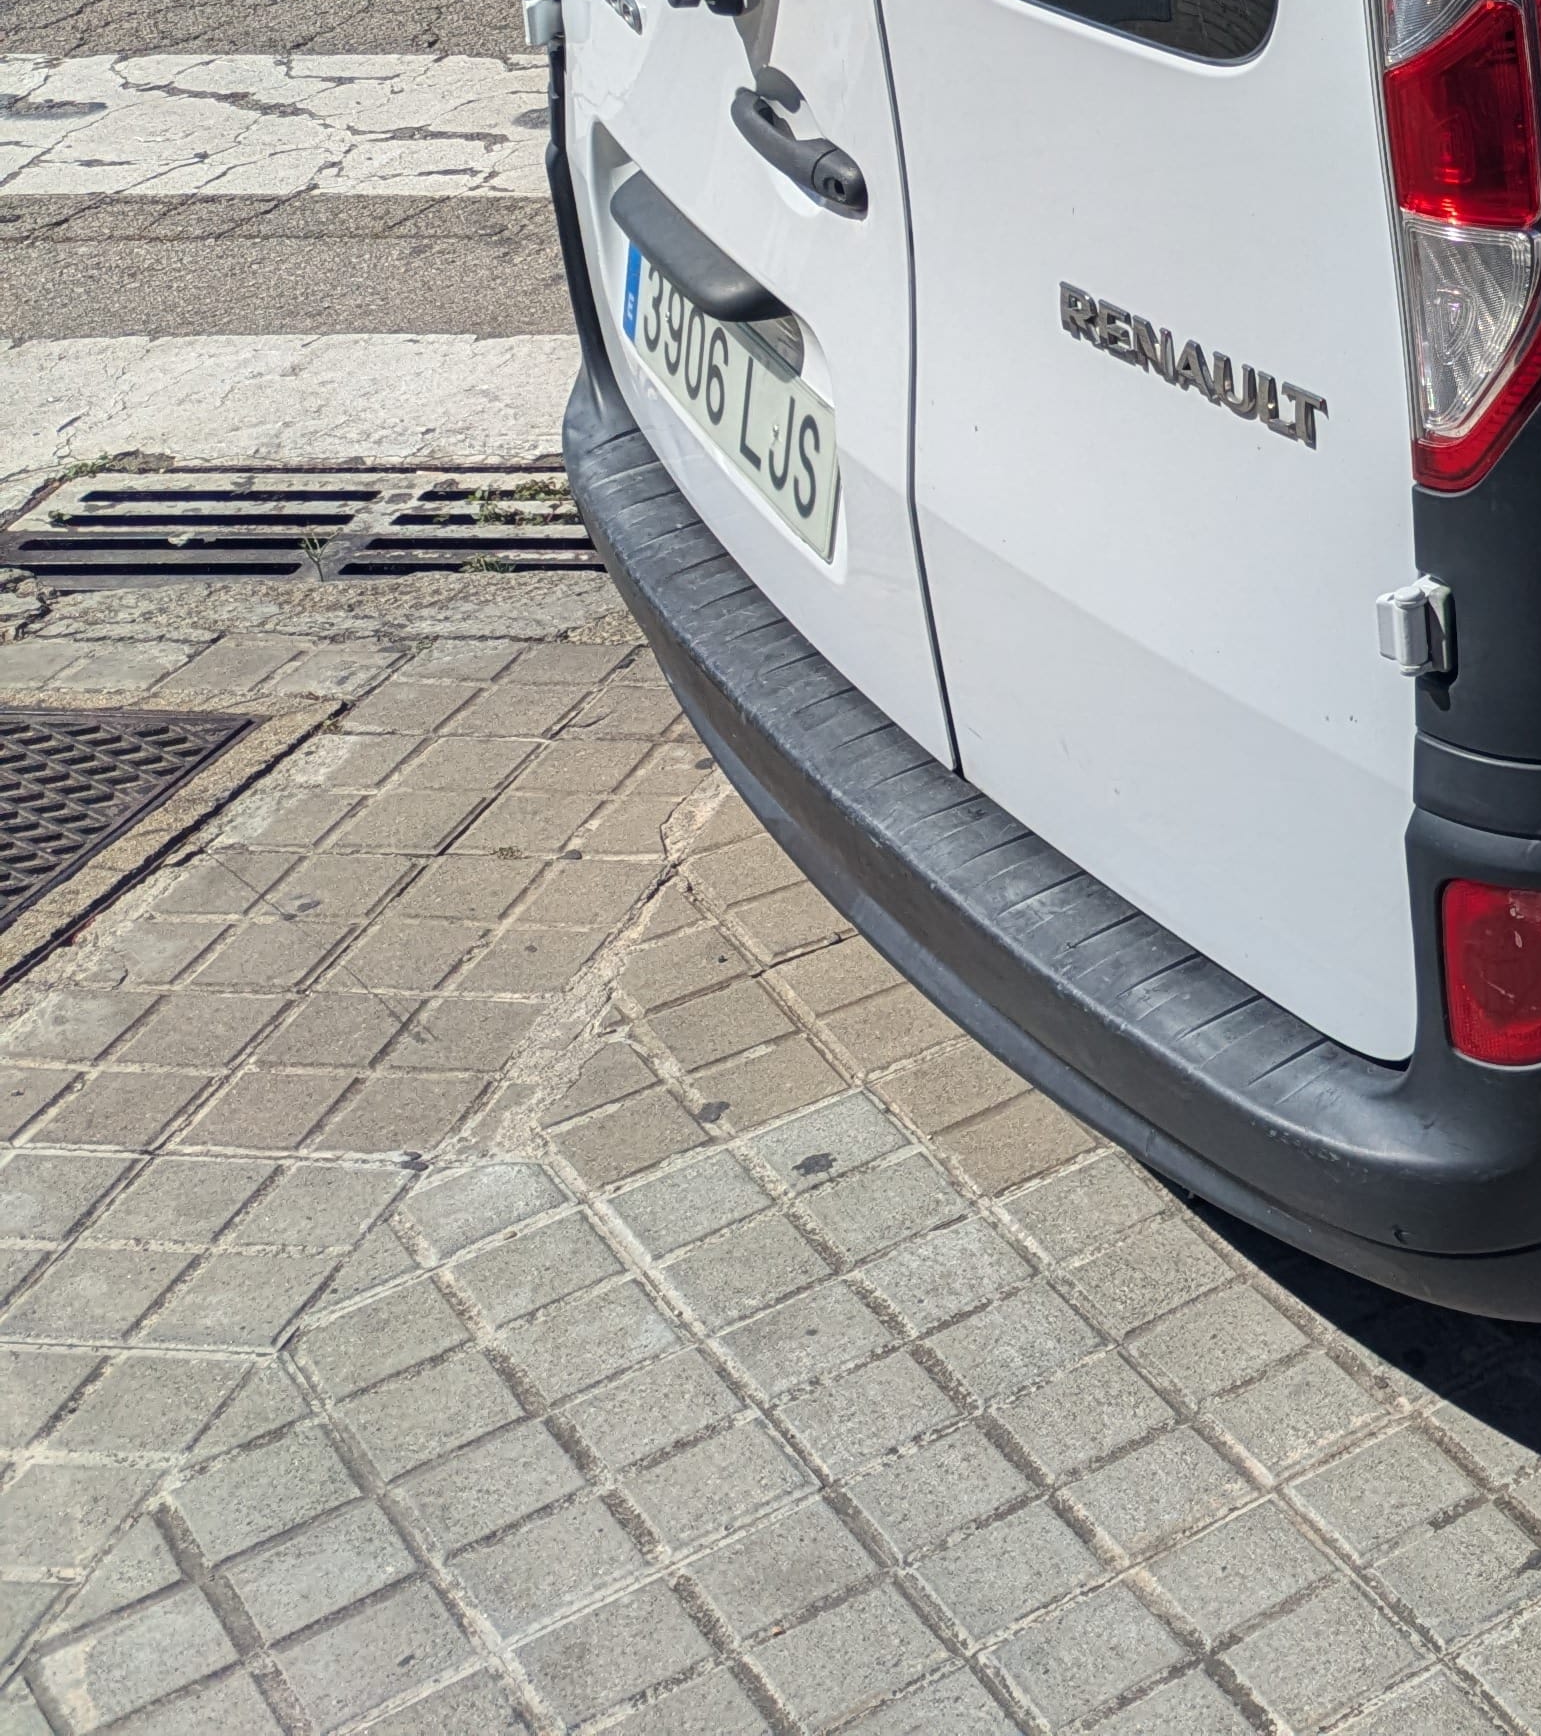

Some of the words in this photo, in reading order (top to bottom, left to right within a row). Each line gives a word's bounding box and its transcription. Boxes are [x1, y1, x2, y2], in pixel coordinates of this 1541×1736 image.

[643, 265, 729, 426] 3906
[739, 355, 821, 520] LJS
[1058, 280, 1330, 451] RENAULT
